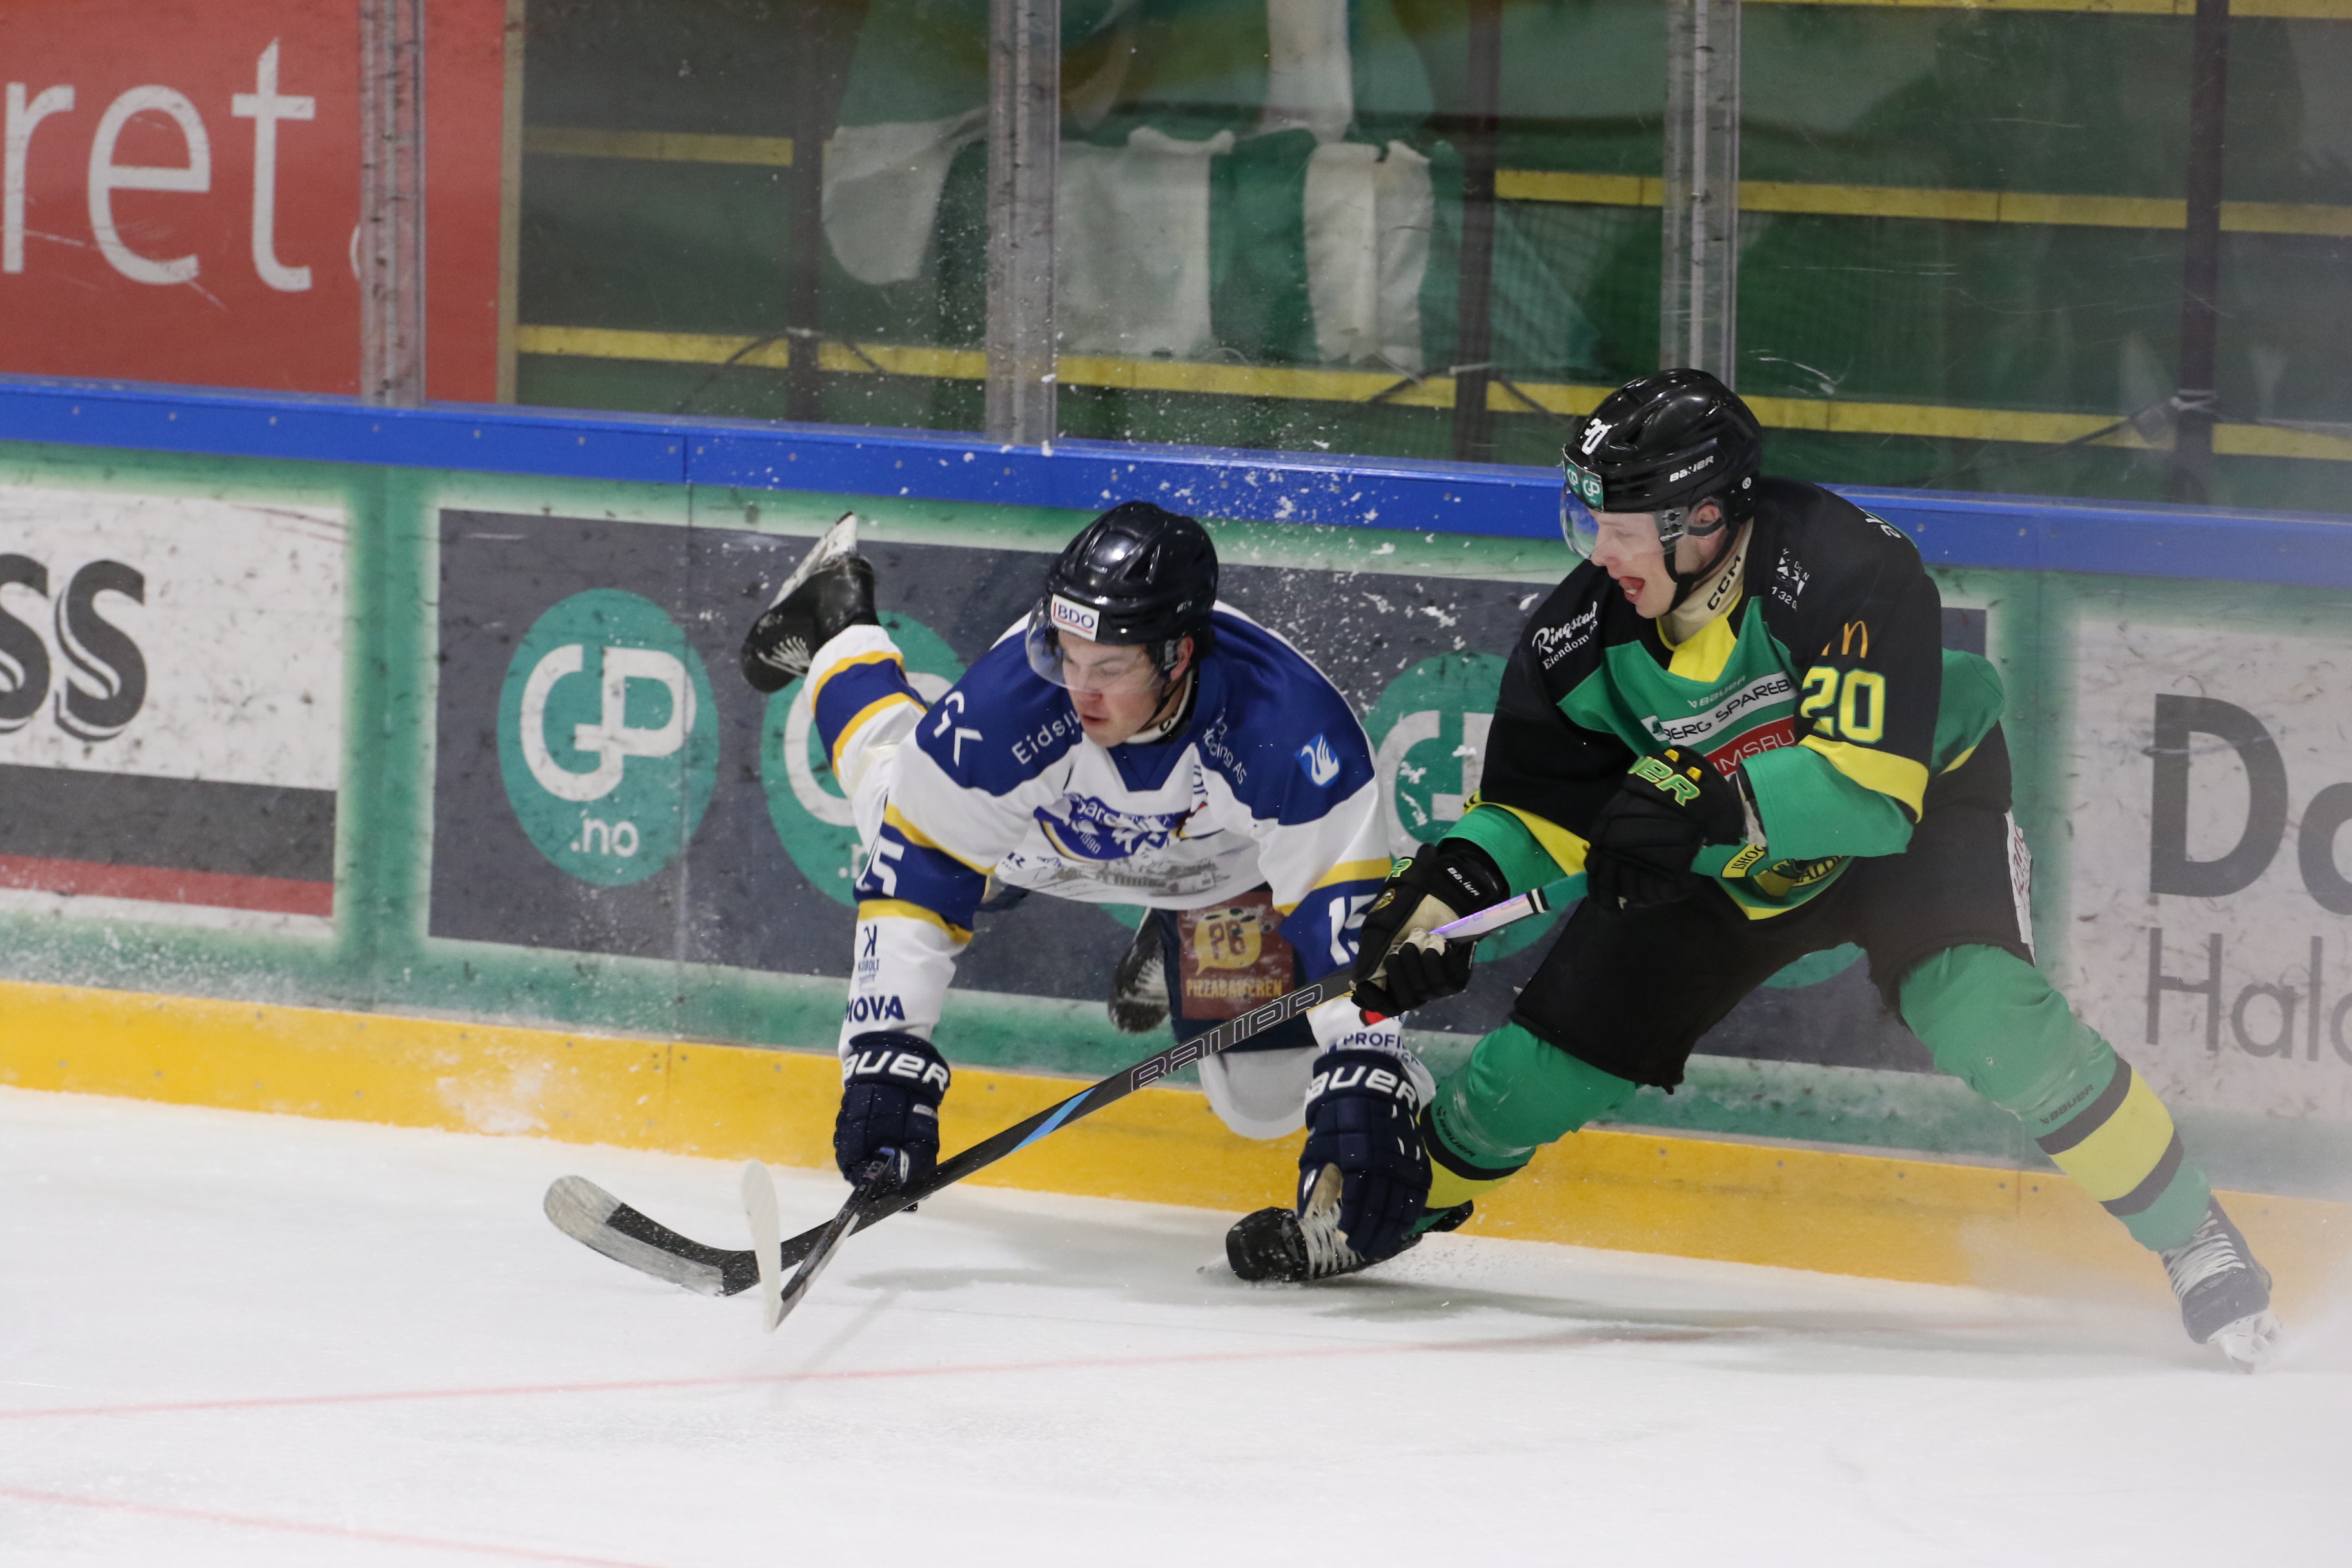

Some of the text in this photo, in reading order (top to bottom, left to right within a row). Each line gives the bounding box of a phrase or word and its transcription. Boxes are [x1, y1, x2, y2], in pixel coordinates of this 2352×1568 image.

[1707, 554, 1741, 611] CCM
[1057, 603, 1095, 629] BDO
[1532, 600, 1598, 656] Ringstad
[1800, 665, 1886, 744] 20
[570, 818, 640, 858] .no
[1131, 983, 1324, 1092] BAUER
